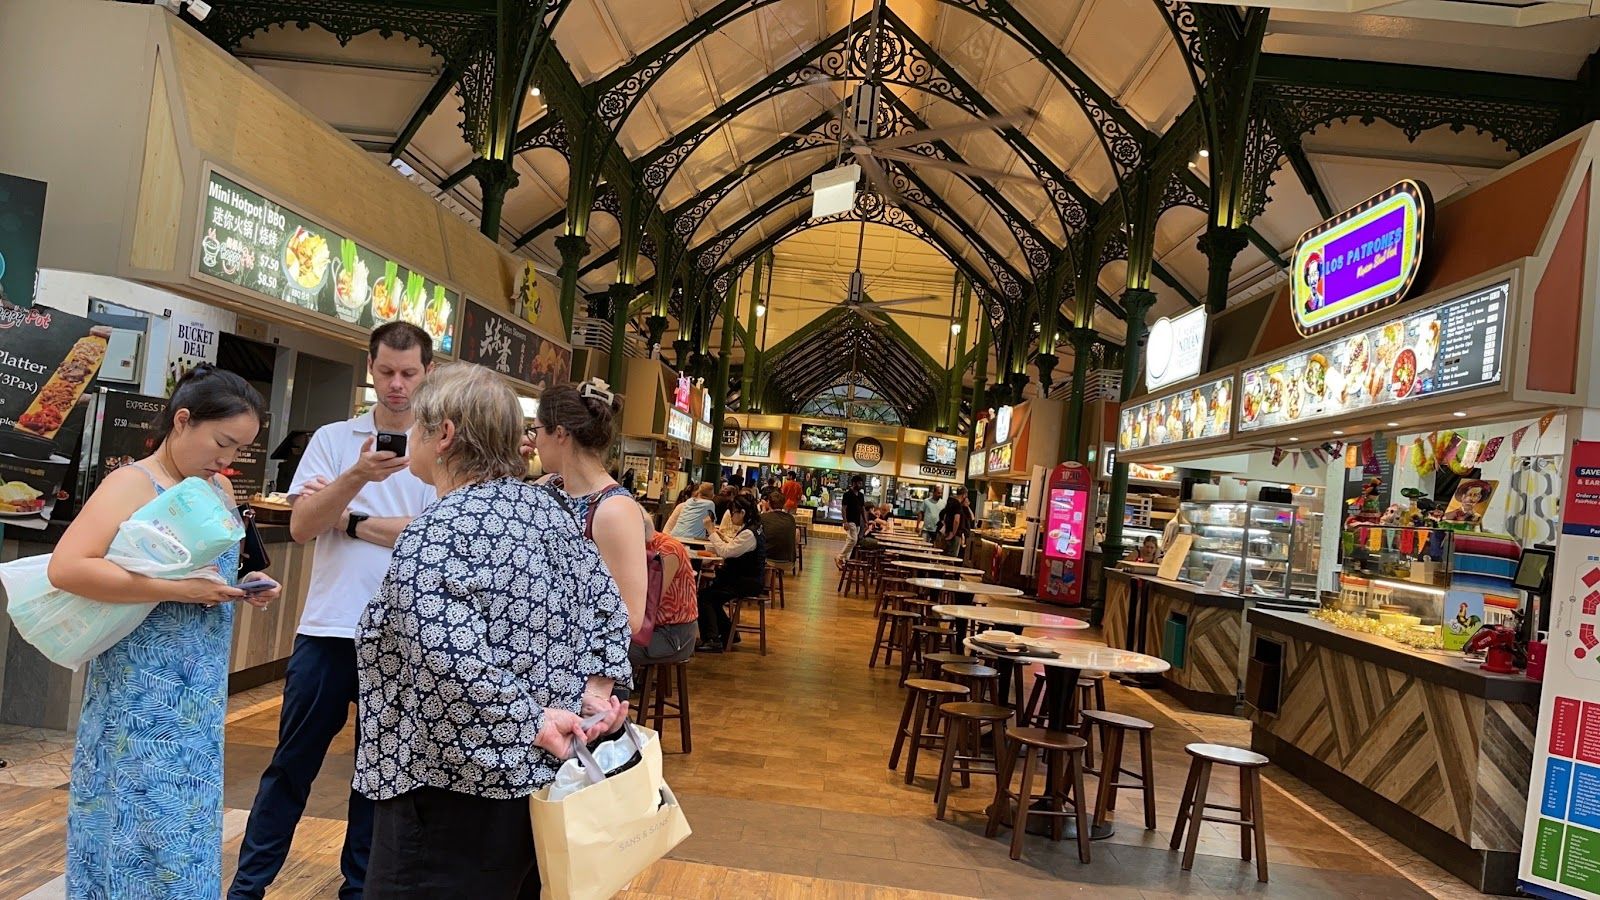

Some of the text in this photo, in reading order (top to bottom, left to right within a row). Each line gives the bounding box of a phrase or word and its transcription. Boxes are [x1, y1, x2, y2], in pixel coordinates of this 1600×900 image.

[209, 181, 286, 231] Mini Hotpot BBQ
[212, 206, 254, 239] 迷你火锅
[1325, 227, 1402, 276] LOS PATRONES
[260, 254, 279, 271] $7.50
[257, 272, 277, 288] $8.50
[178, 324, 214, 345] BUCKET
[183, 340, 206, 358] DEAL
[126, 400, 159, 412] EXPRESS
[857, 444, 880, 453] FRESH
[1580, 468, 1600, 476] SAVE
